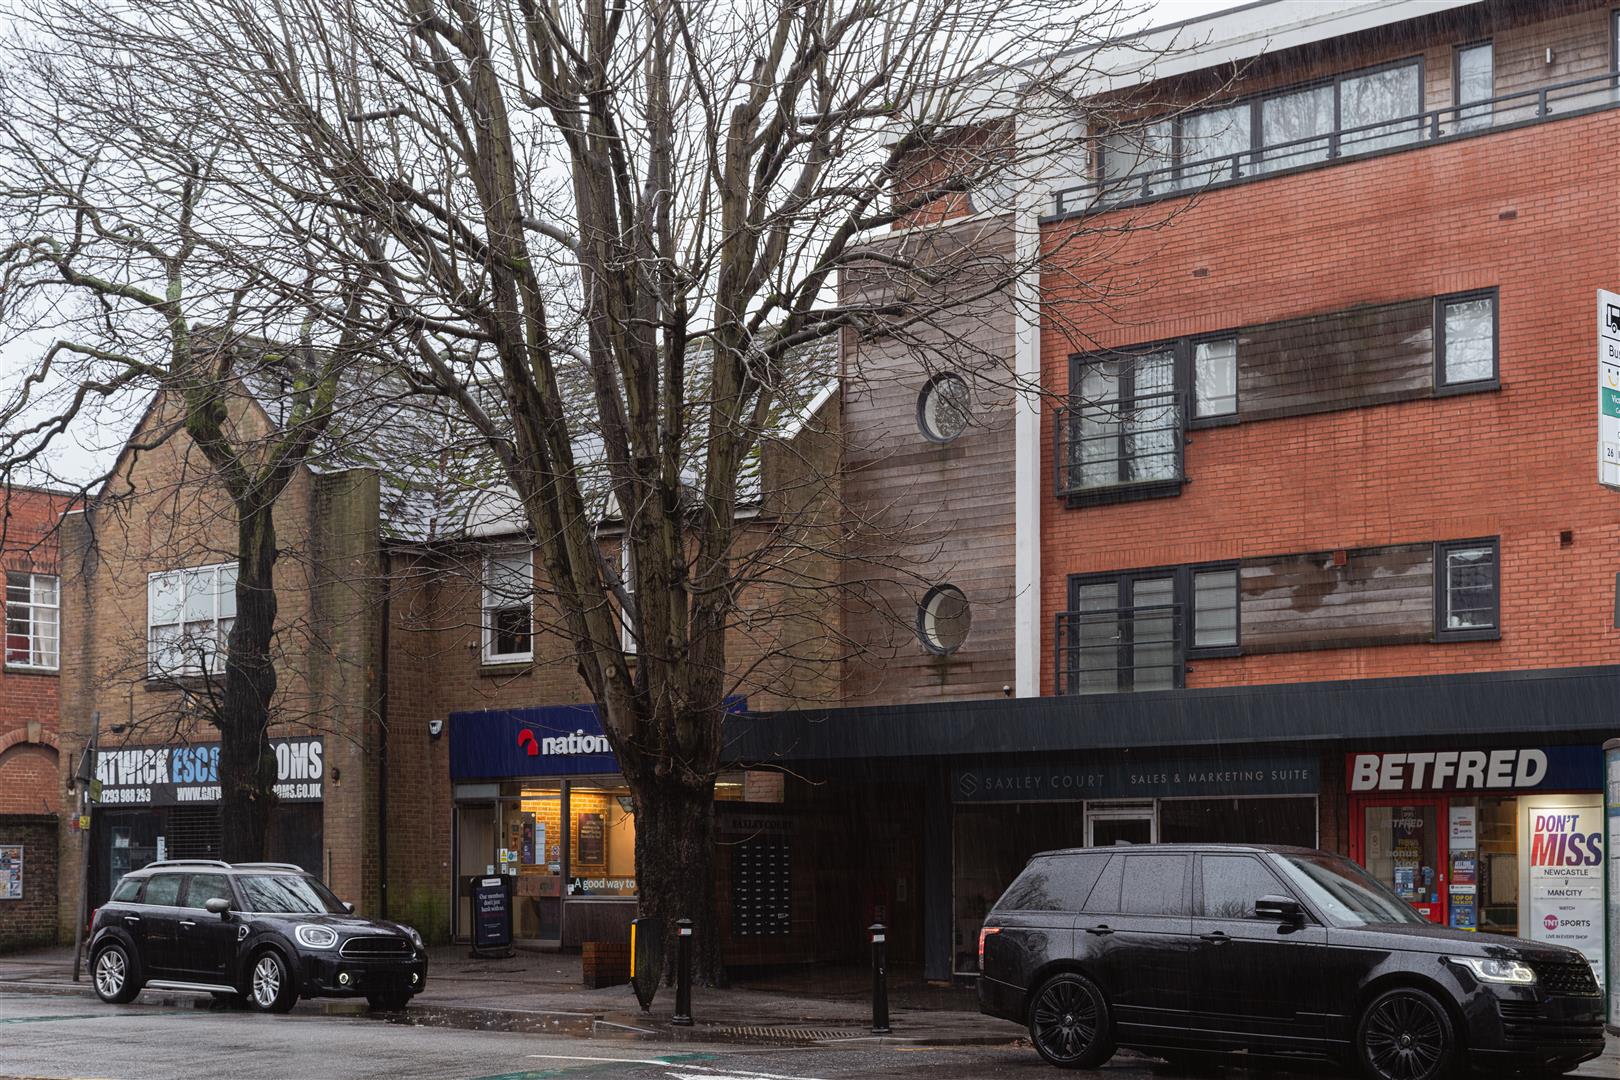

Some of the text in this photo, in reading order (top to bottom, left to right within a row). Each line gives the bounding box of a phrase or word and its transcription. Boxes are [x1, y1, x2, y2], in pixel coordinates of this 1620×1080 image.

[542, 728, 614, 756] nation
[96, 748, 169, 785] ATWICK
[269, 741, 323, 780] OMS
[1351, 748, 1548, 791] BETFRED
[985, 776, 1041, 790] SAXLEY
[1051, 774, 1105, 788] COURT
[1130, 769, 1309, 785] SALES & MARKETING SUITE
[99, 789, 120, 803] 1293
[1535, 815, 1579, 833] DON'T
[1531, 832, 1602, 867] MISS
[574, 877, 636, 891] A good way to
[1547, 889, 1583, 897] MAN CITY
[1560, 919, 1591, 927] SPORTS
